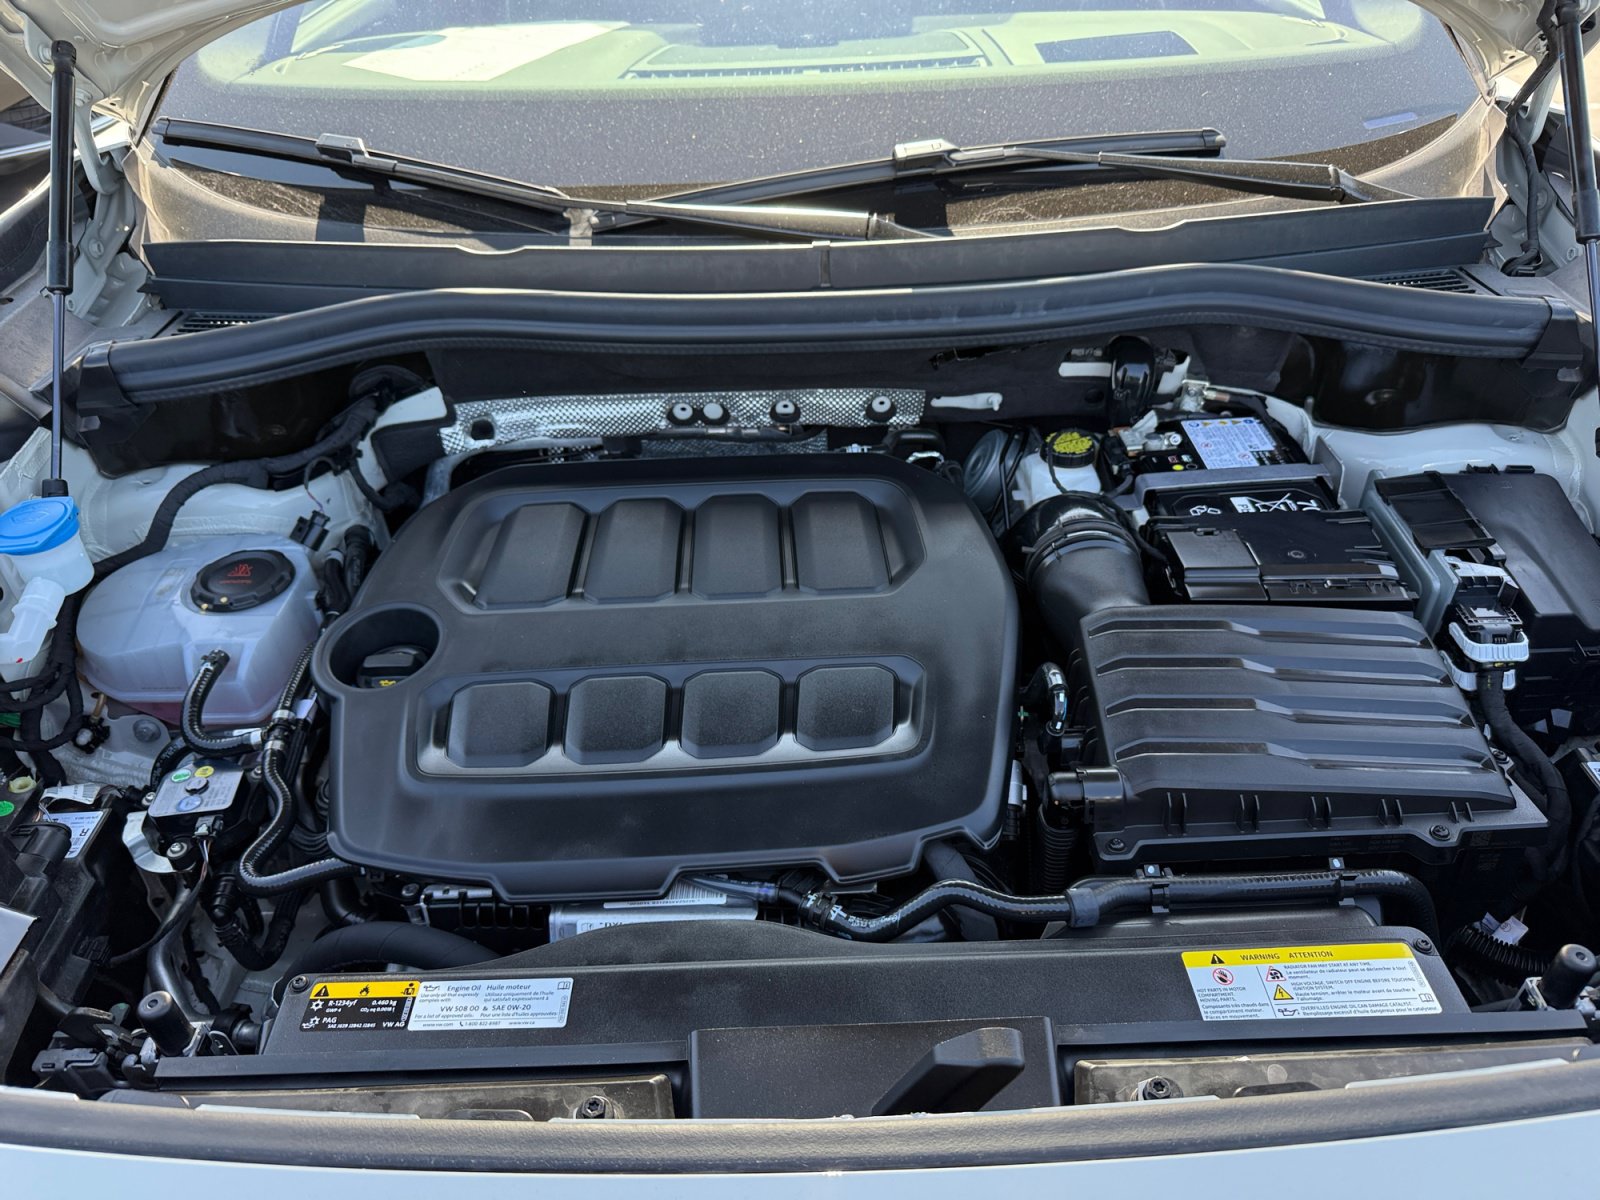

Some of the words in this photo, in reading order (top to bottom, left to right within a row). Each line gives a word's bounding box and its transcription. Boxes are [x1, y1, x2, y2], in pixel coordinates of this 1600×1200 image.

[1240, 953, 1280, 961] WARNING
[1289, 951, 1334, 959] ATTENTION
[328, 999, 358, 1008] R-1234yf
